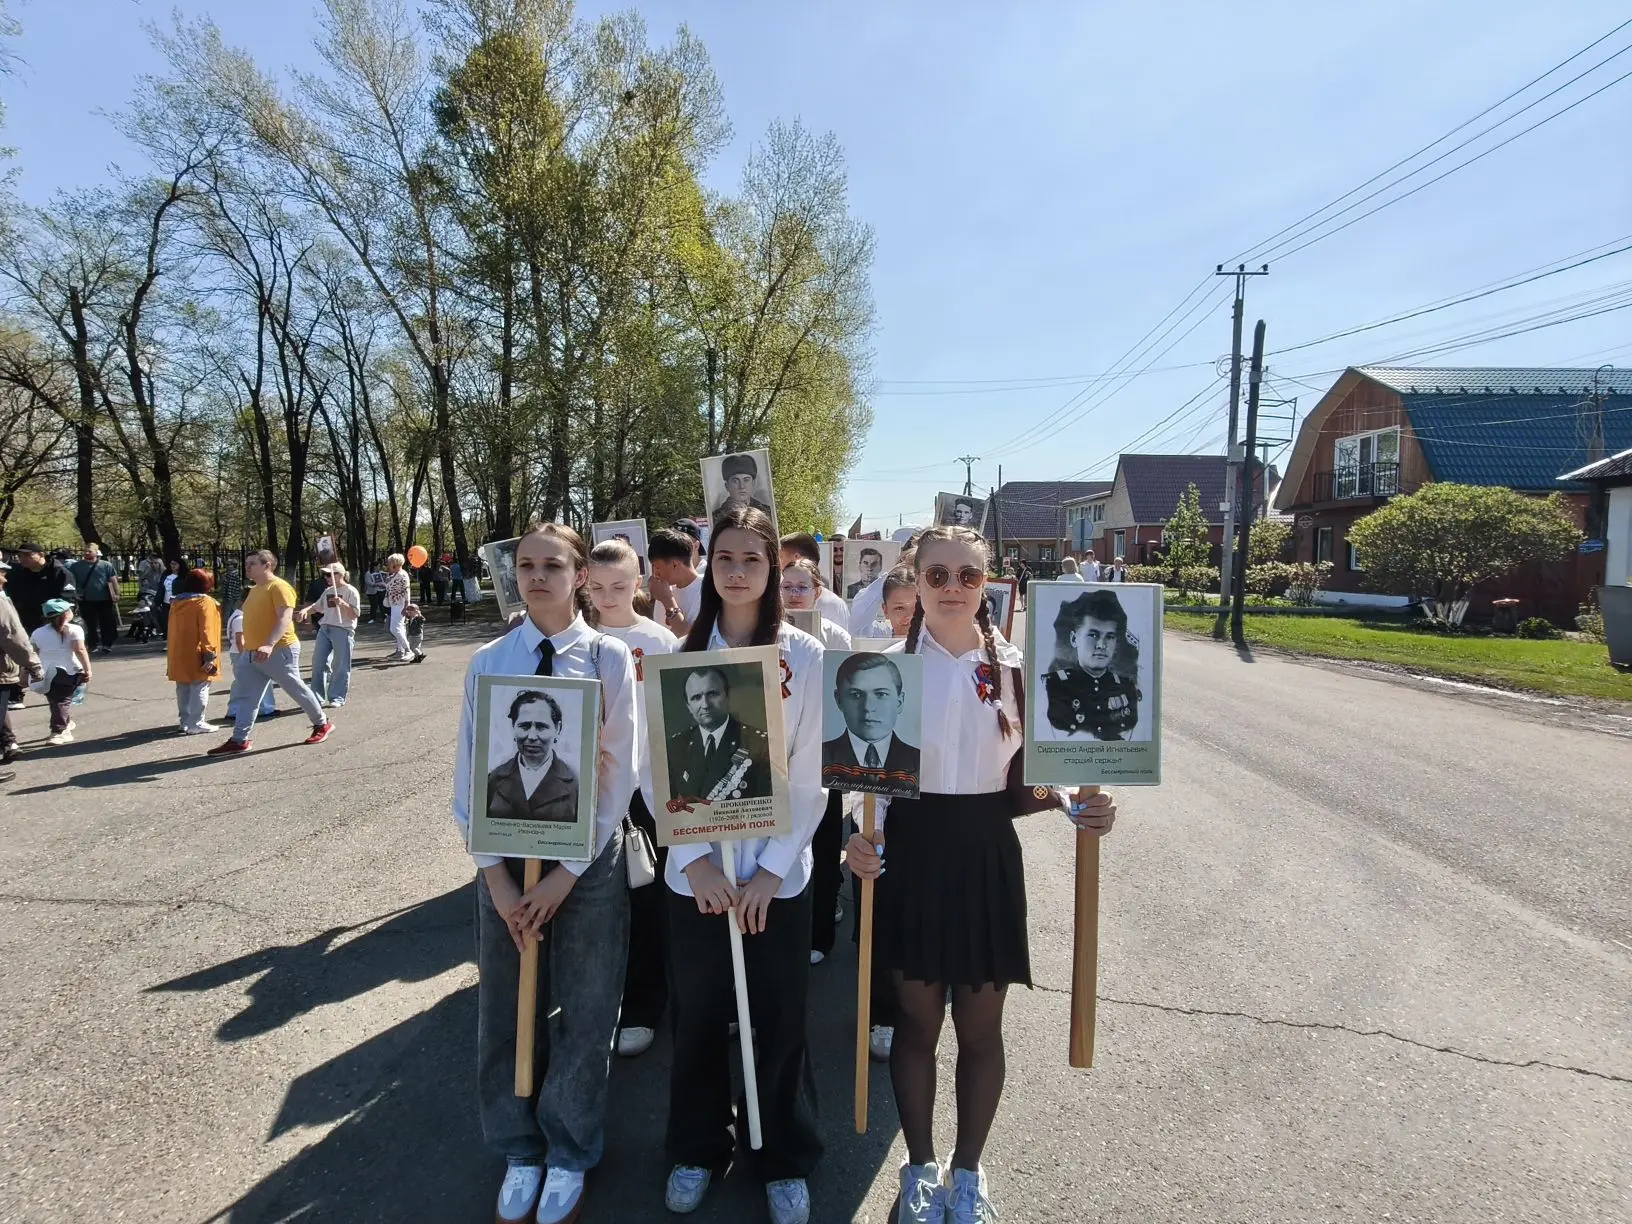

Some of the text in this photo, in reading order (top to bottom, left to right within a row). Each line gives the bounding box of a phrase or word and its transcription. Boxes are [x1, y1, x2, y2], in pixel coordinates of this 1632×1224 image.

[1037, 745, 1148, 754] Сидоренко Андрей Игнатьевич
[1063, 757, 1122, 765] старший сержант
[720, 798, 772, 809] ПРОКОПЧЕНКО
[713, 808, 739, 816] Николай
[673, 819, 776, 836] БЕССМЕРТНЫЙ ПОЛК
